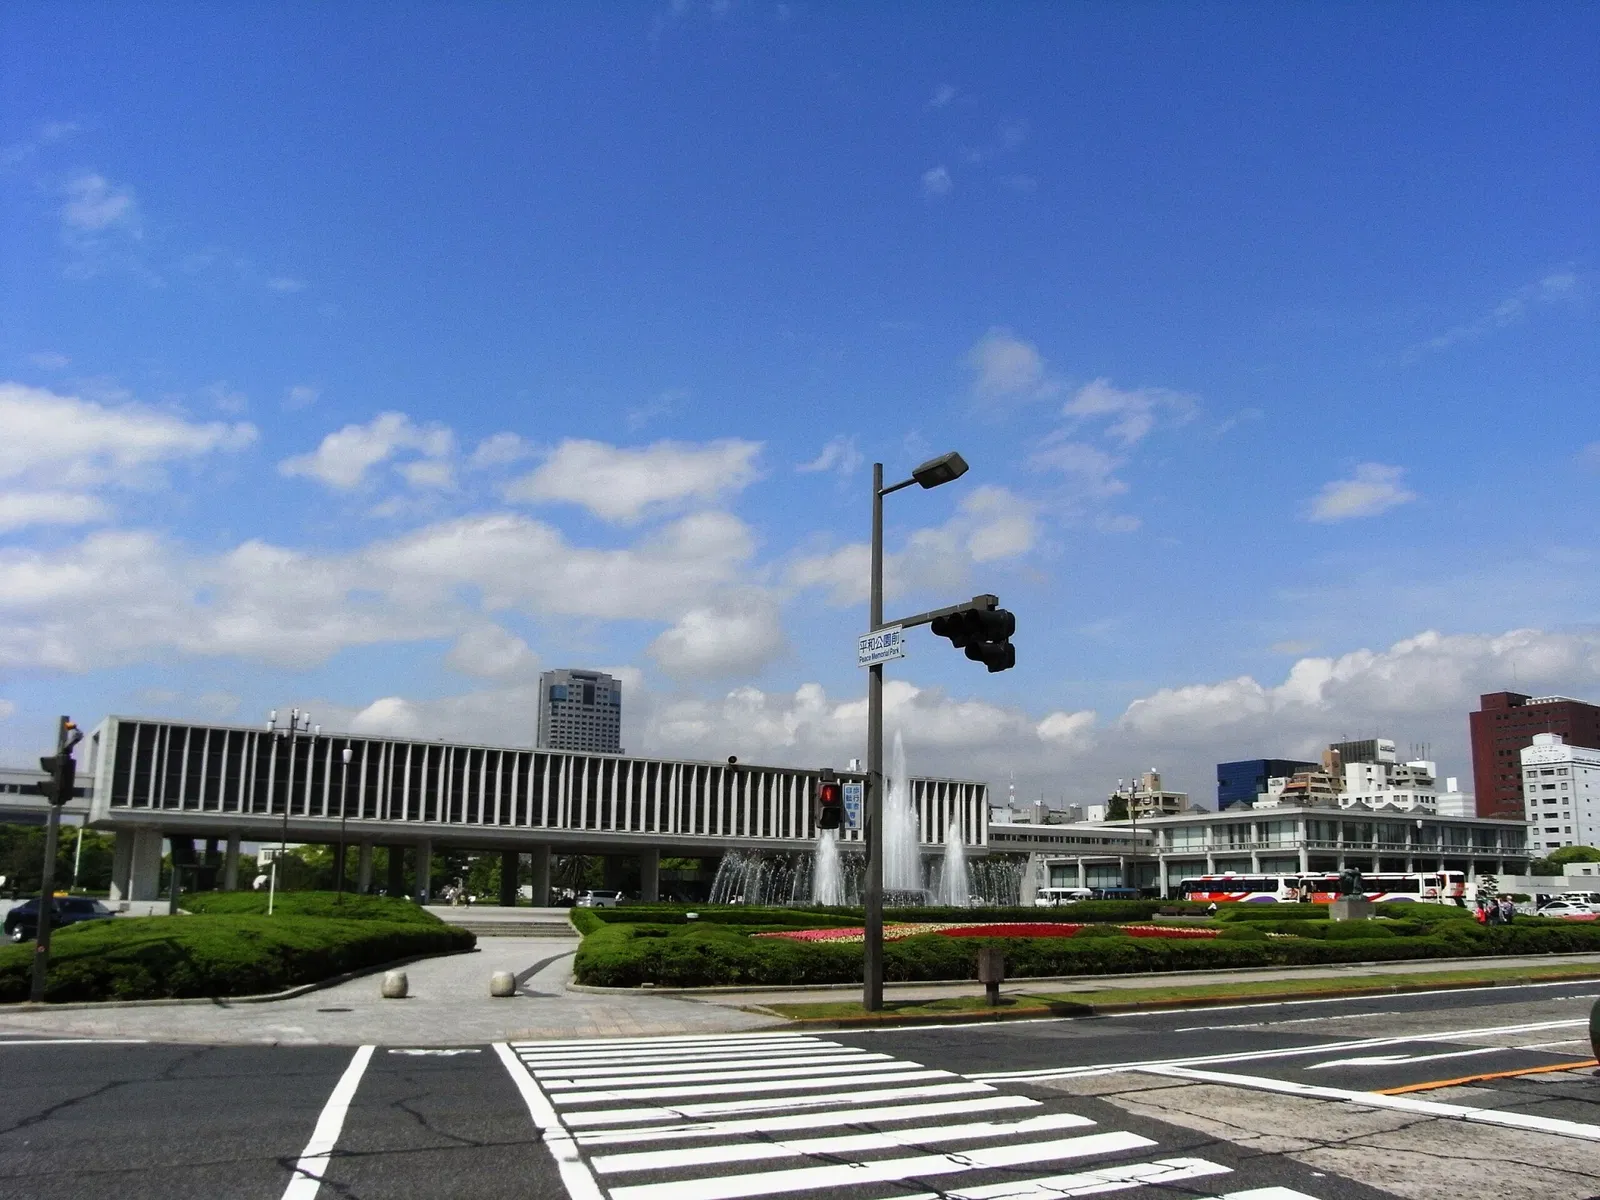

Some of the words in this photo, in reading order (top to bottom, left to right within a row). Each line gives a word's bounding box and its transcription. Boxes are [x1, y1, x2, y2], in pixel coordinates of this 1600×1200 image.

[860, 632, 899, 653] 平和公園前
[872, 651, 889, 660] Memorial
[890, 647, 899, 655] Park
